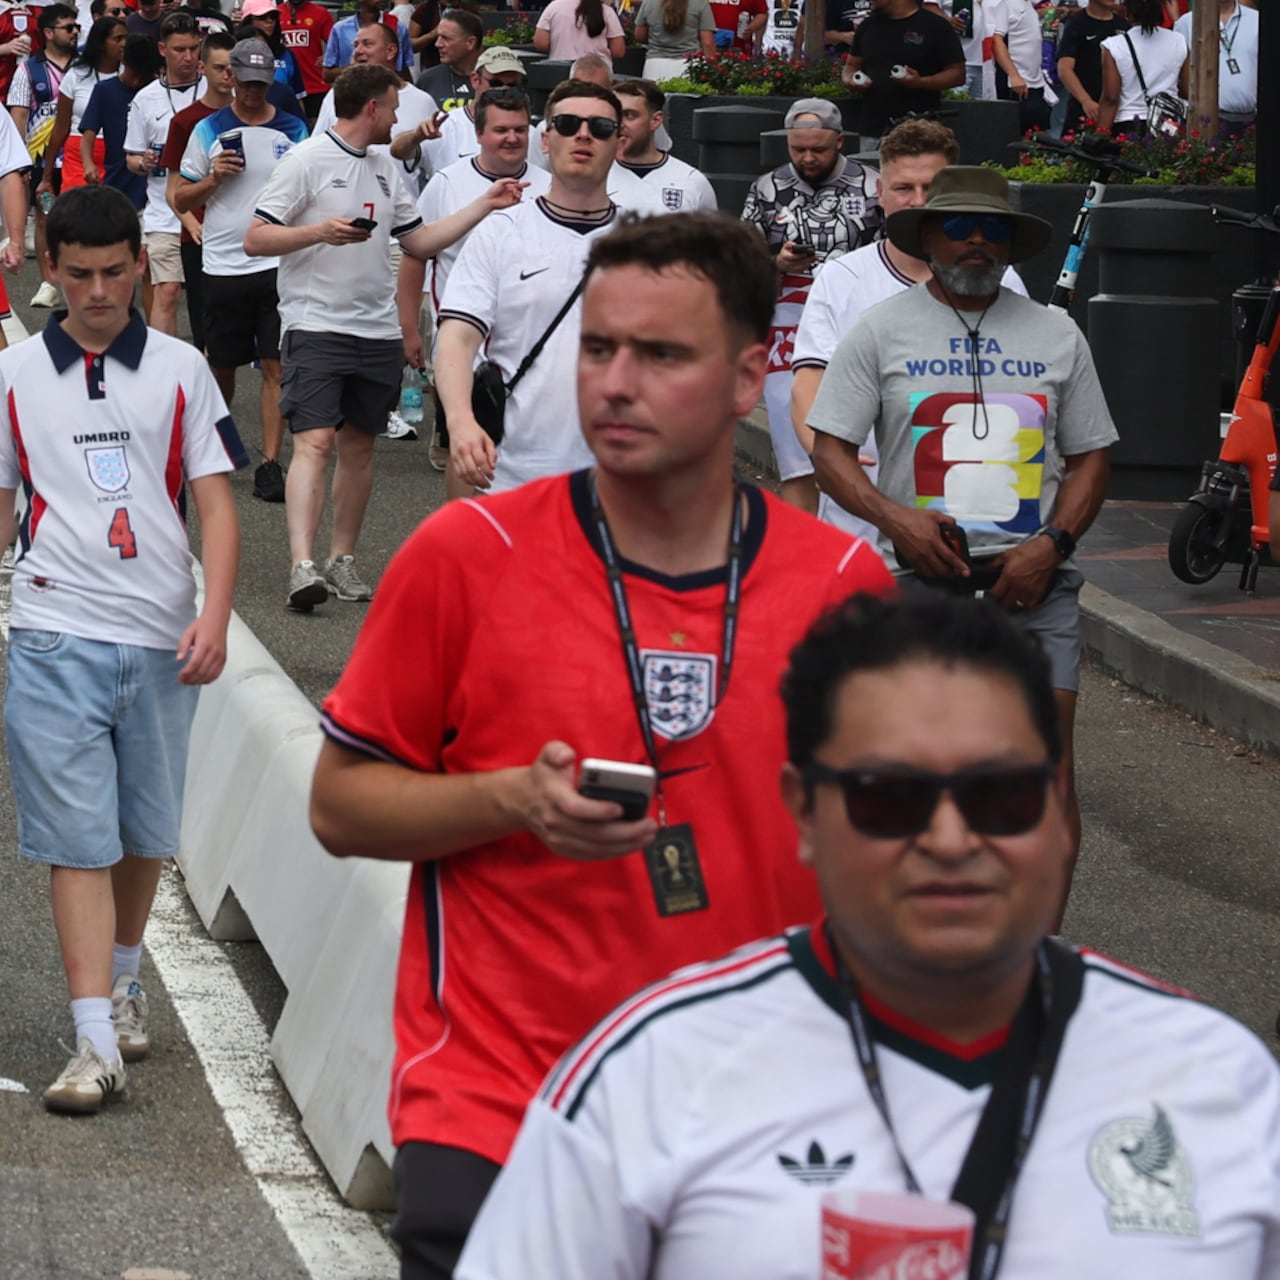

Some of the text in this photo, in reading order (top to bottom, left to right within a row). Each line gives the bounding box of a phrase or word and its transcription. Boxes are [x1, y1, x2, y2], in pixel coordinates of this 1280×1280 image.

[284, 31, 307, 46] AIG
[363, 203, 374, 221] 7
[949, 337, 1002, 354] FIFA
[906, 359, 1047, 378] WORLD CUP
[73, 431, 130, 444] UMBRO
[107, 507, 138, 560] 4
